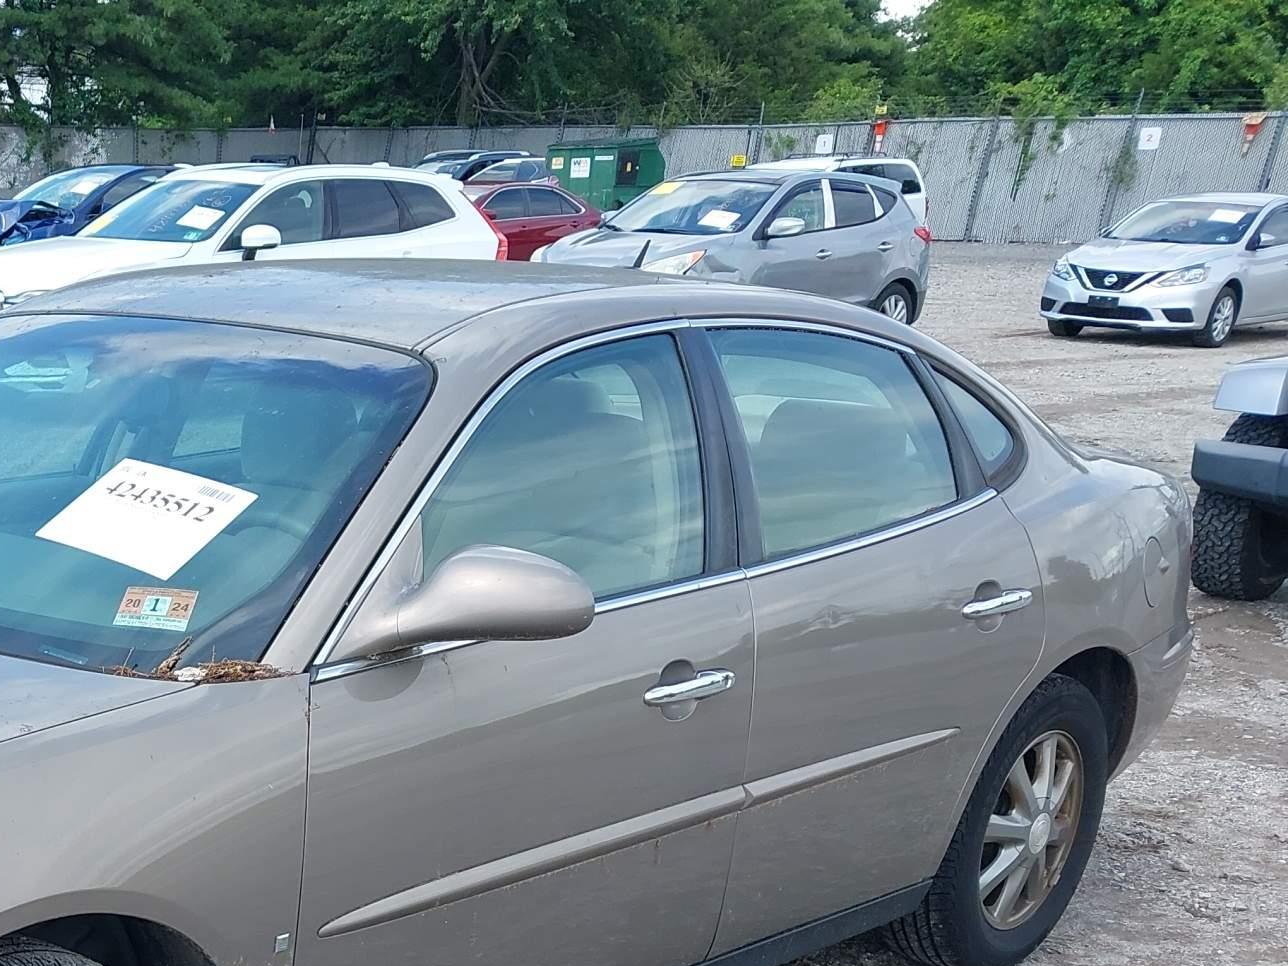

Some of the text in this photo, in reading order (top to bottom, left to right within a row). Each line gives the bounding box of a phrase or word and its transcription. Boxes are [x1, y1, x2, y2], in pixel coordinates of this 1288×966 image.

[106, 481, 215, 522] 42435512
[125, 598, 189, 612] 20 1 24
